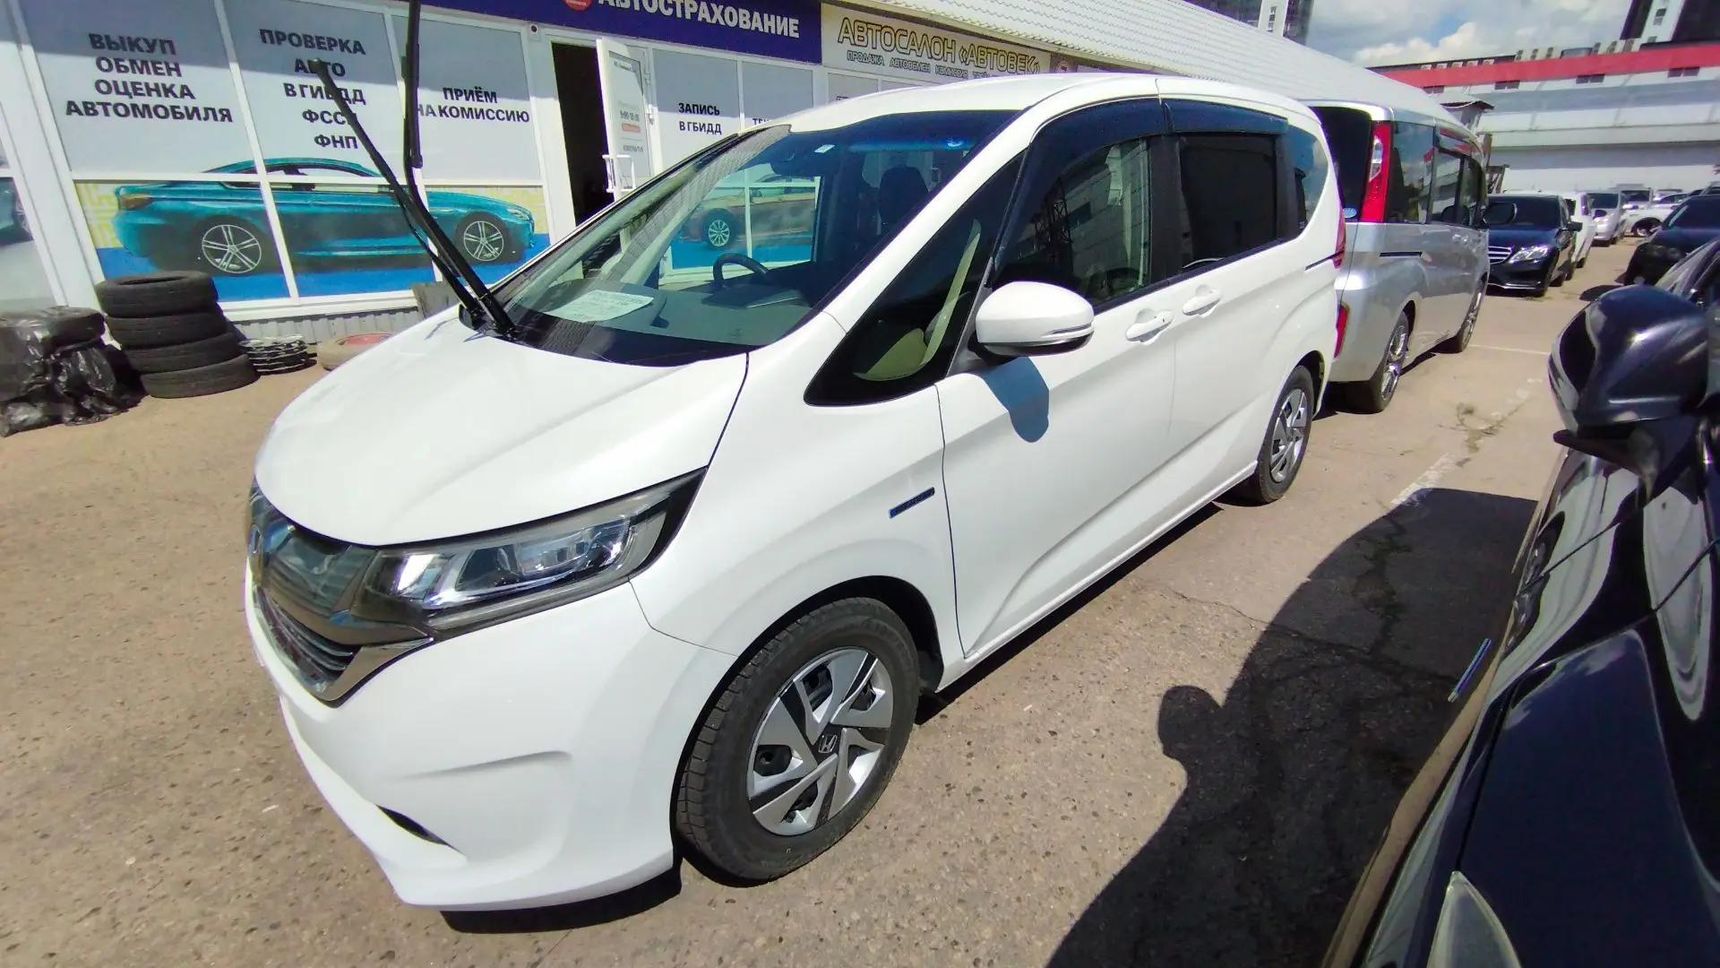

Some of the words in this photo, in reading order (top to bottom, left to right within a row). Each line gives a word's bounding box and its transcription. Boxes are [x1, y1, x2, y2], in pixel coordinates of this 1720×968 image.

[88, 33, 177, 55] ВЫКУП
[259, 28, 366, 55] ПРОВЕРКА
[837, 16, 957, 63] АВТОСАЛОН
[95, 56, 182, 77] ОБМЕН
[94, 79, 196, 100] ОЦЕНКА
[284, 82, 297, 98] В
[442, 86, 498, 104] ПРИЁМ
[66, 100, 233, 122] АВТОМОБИЛЯ
[302, 109, 355, 125] ФСС
[439, 104, 530, 123] КОМИССИЮ
[678, 102, 720, 116] ЗАПИСЬ
[679, 121, 686, 131] В
[687, 121, 722, 135] ГБИДД
[314, 134, 359, 150] ФНП
